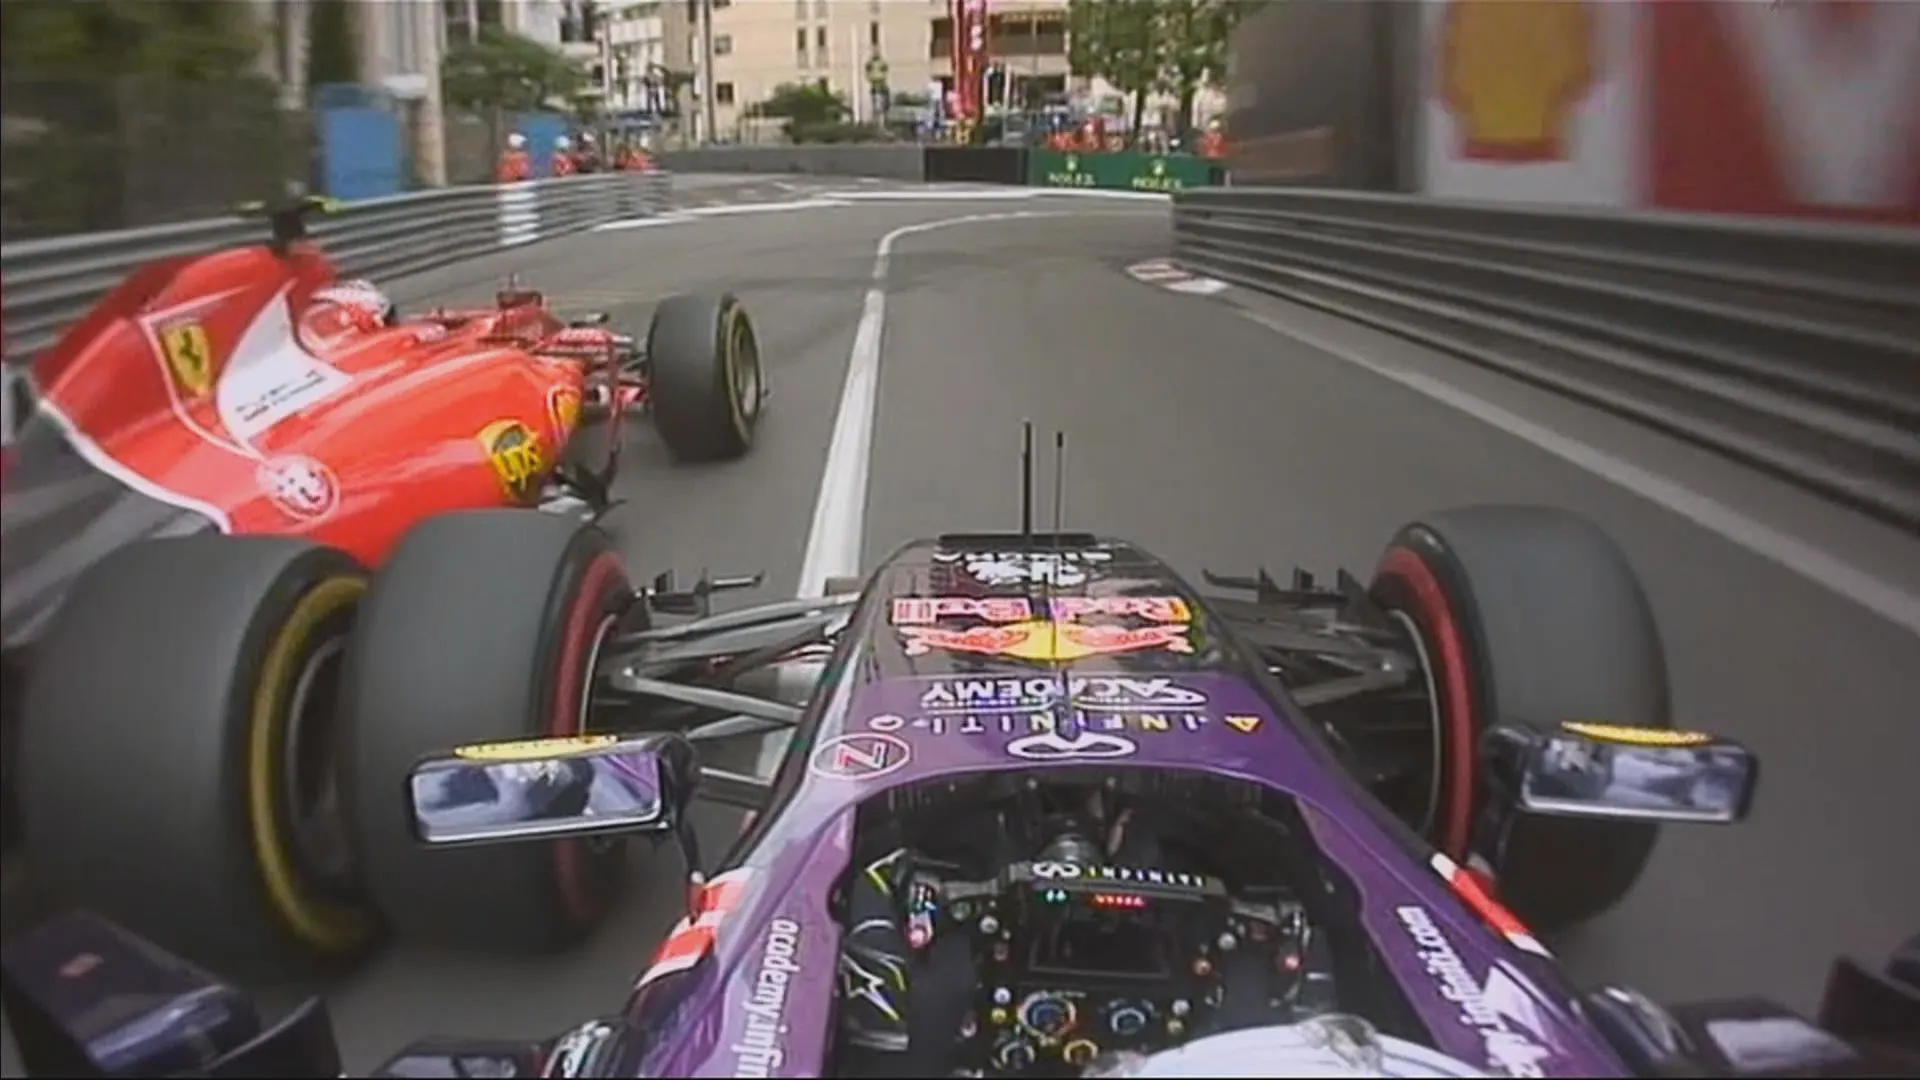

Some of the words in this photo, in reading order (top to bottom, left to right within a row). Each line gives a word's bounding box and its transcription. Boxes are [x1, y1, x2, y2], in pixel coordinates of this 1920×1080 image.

[892, 597, 1033, 623] Bull
[1048, 597, 1192, 622] Red
[931, 713, 1198, 734] INFINITI
